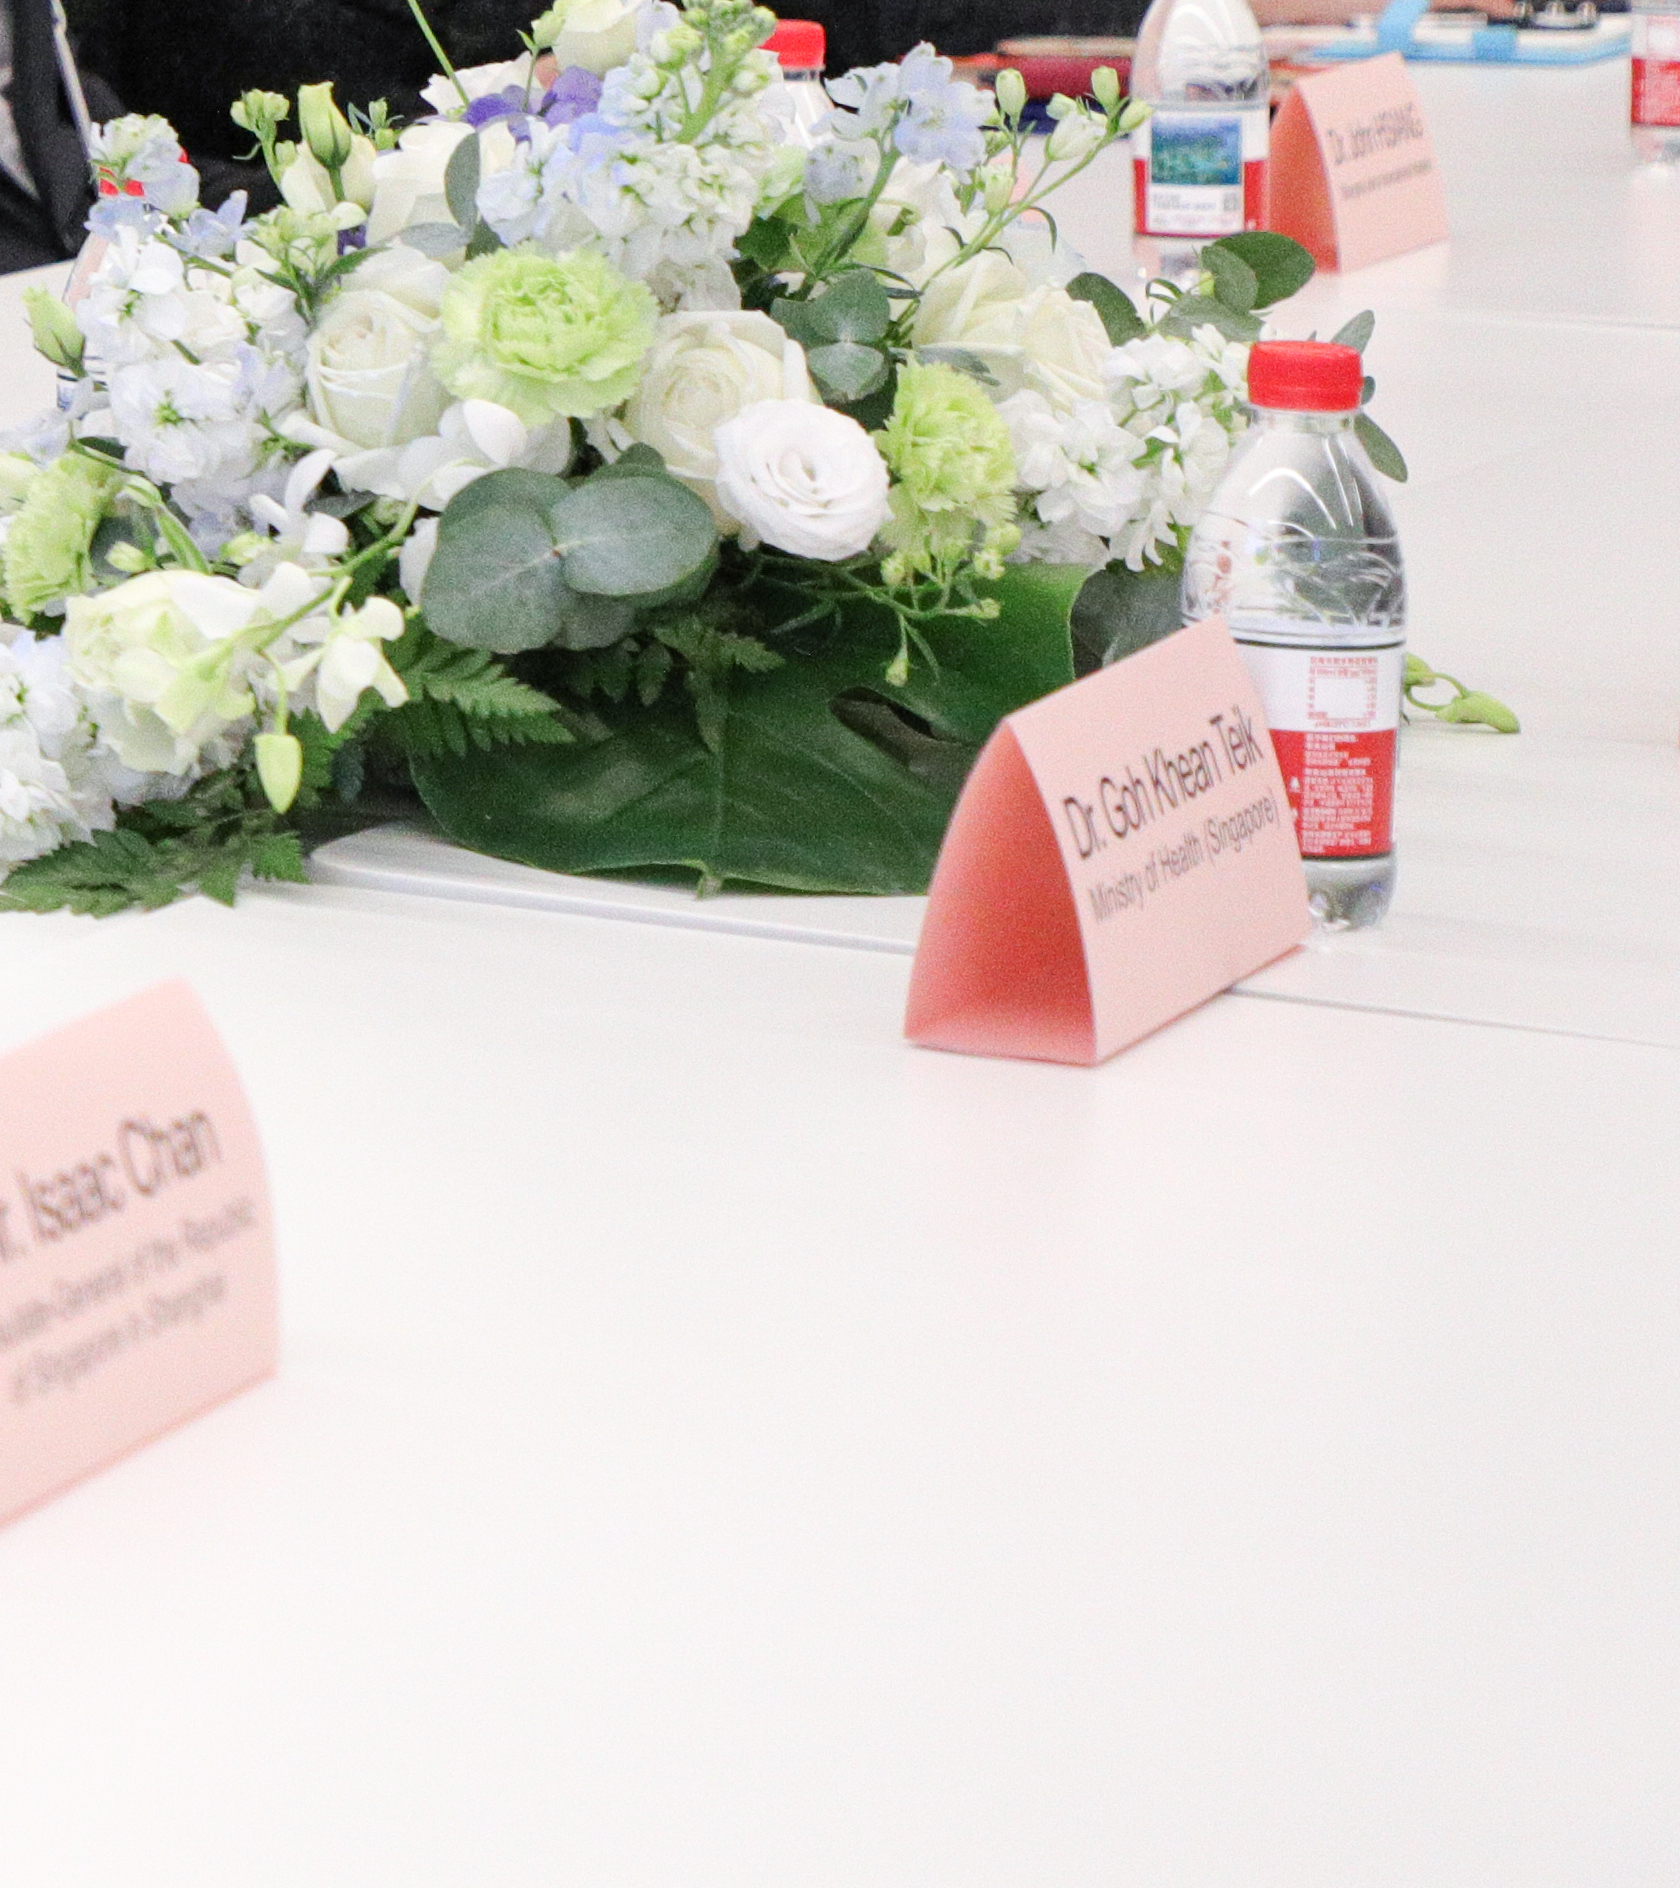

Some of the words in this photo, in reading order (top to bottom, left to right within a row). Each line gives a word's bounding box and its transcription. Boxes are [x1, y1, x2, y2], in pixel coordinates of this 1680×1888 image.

[1063, 797, 1107, 859] Dr.
[1100, 765, 1155, 839] Goh
[1143, 740, 1222, 816] Khean
[1209, 704, 1264, 775] Teik
[1088, 871, 1144, 923] Ministry
[1145, 851, 1160, 892] of
[1160, 830, 1204, 881] Health
[1203, 785, 1280, 867] (Singapore)
[16, 1152, 126, 1244] Isaac
[116, 1110, 223, 1198] Chan
